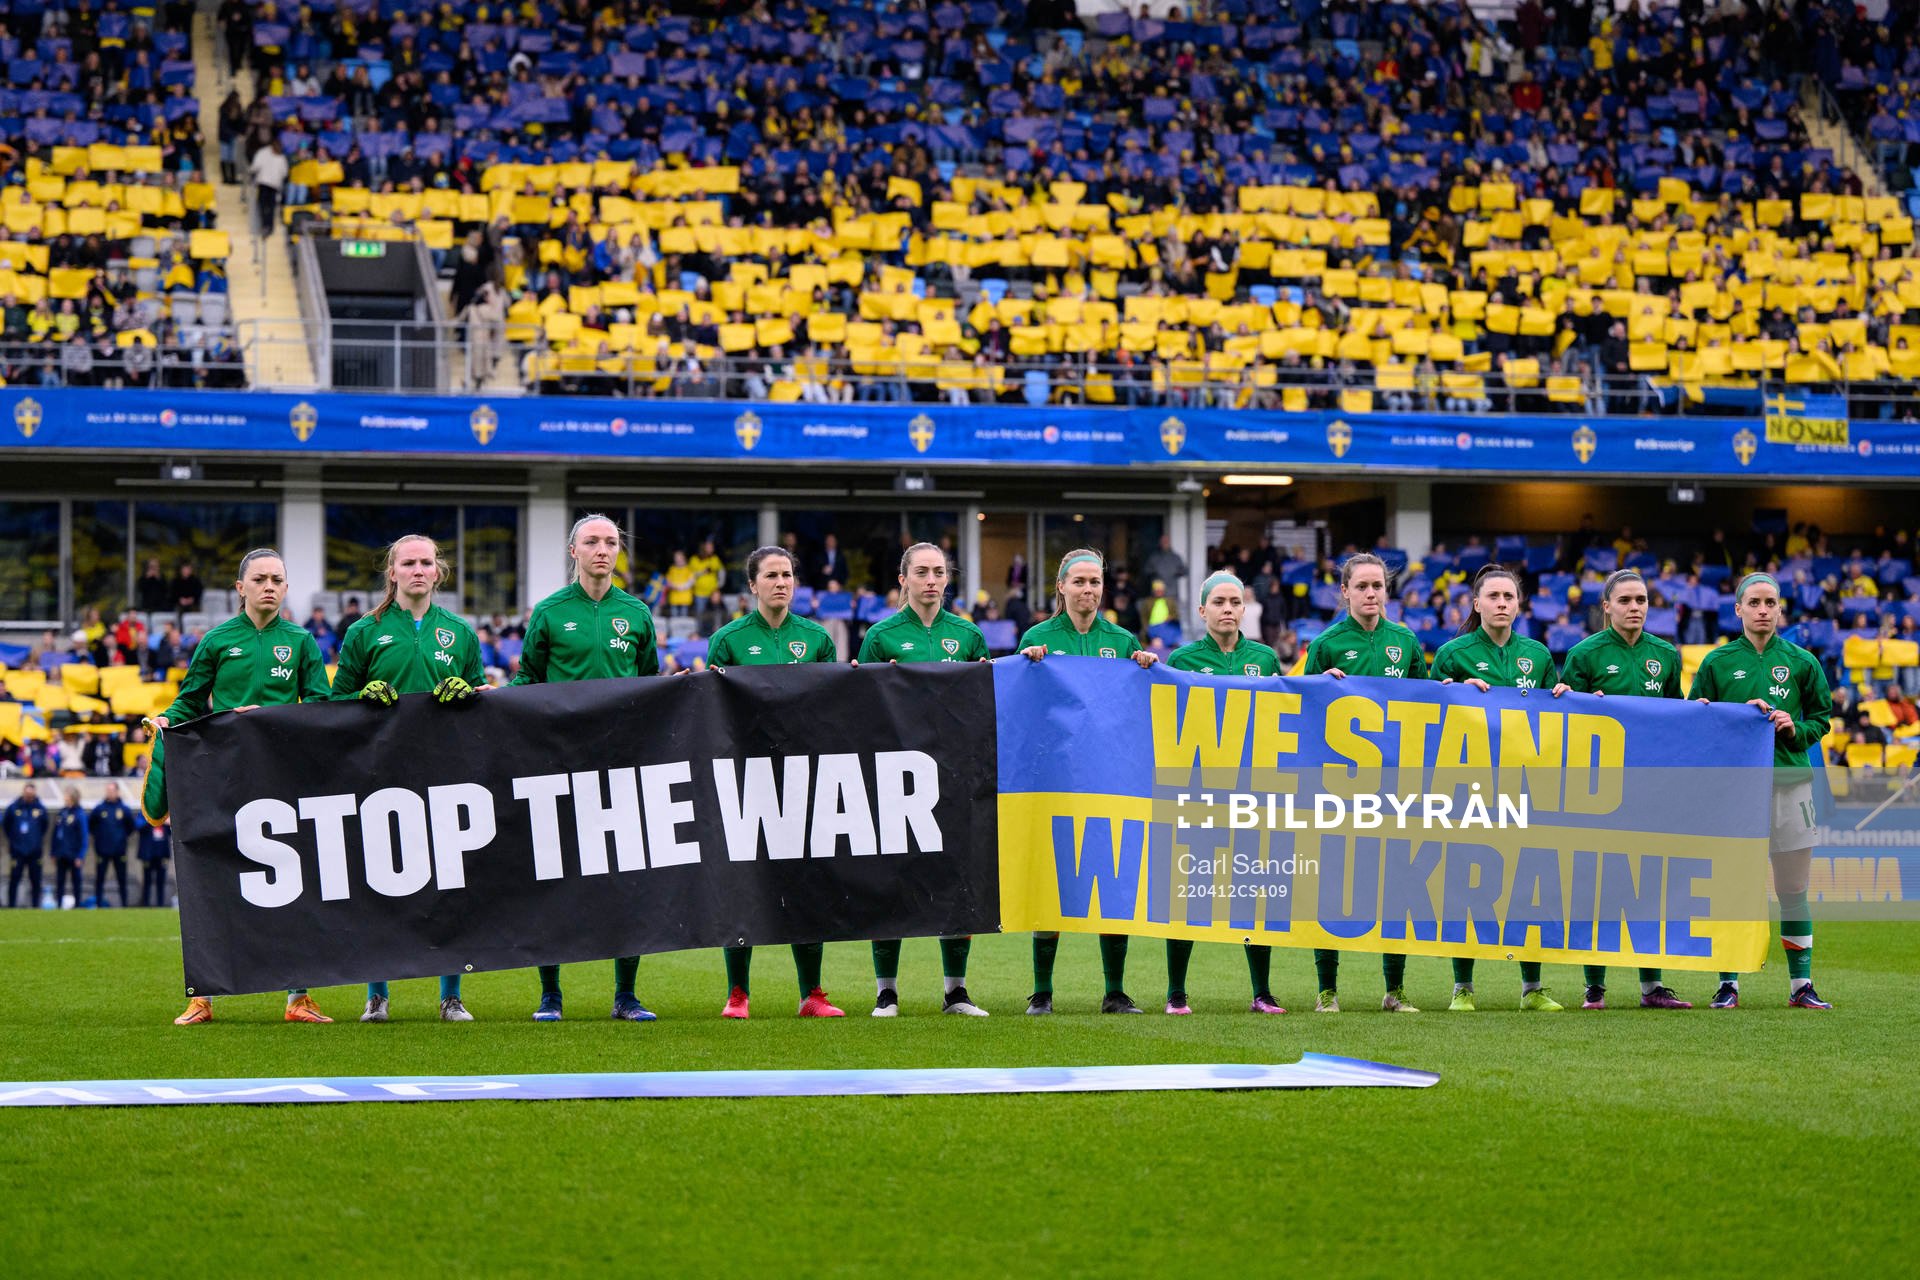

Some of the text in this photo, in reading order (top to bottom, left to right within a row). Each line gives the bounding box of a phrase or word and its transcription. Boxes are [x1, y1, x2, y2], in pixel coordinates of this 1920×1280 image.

[611, 637, 630, 653] sky
[435, 650, 454, 666] sky
[270, 661, 293, 681] sky
[1384, 665, 1404, 679] sky
[1517, 675, 1536, 689] sky
[1646, 678, 1662, 693] sky
[1769, 684, 1790, 699] sky
[1151, 684, 1626, 815] WE STAND
[235, 751, 943, 907] STOP THE WAR
[1052, 815, 1713, 958] WITH UKRAINE
